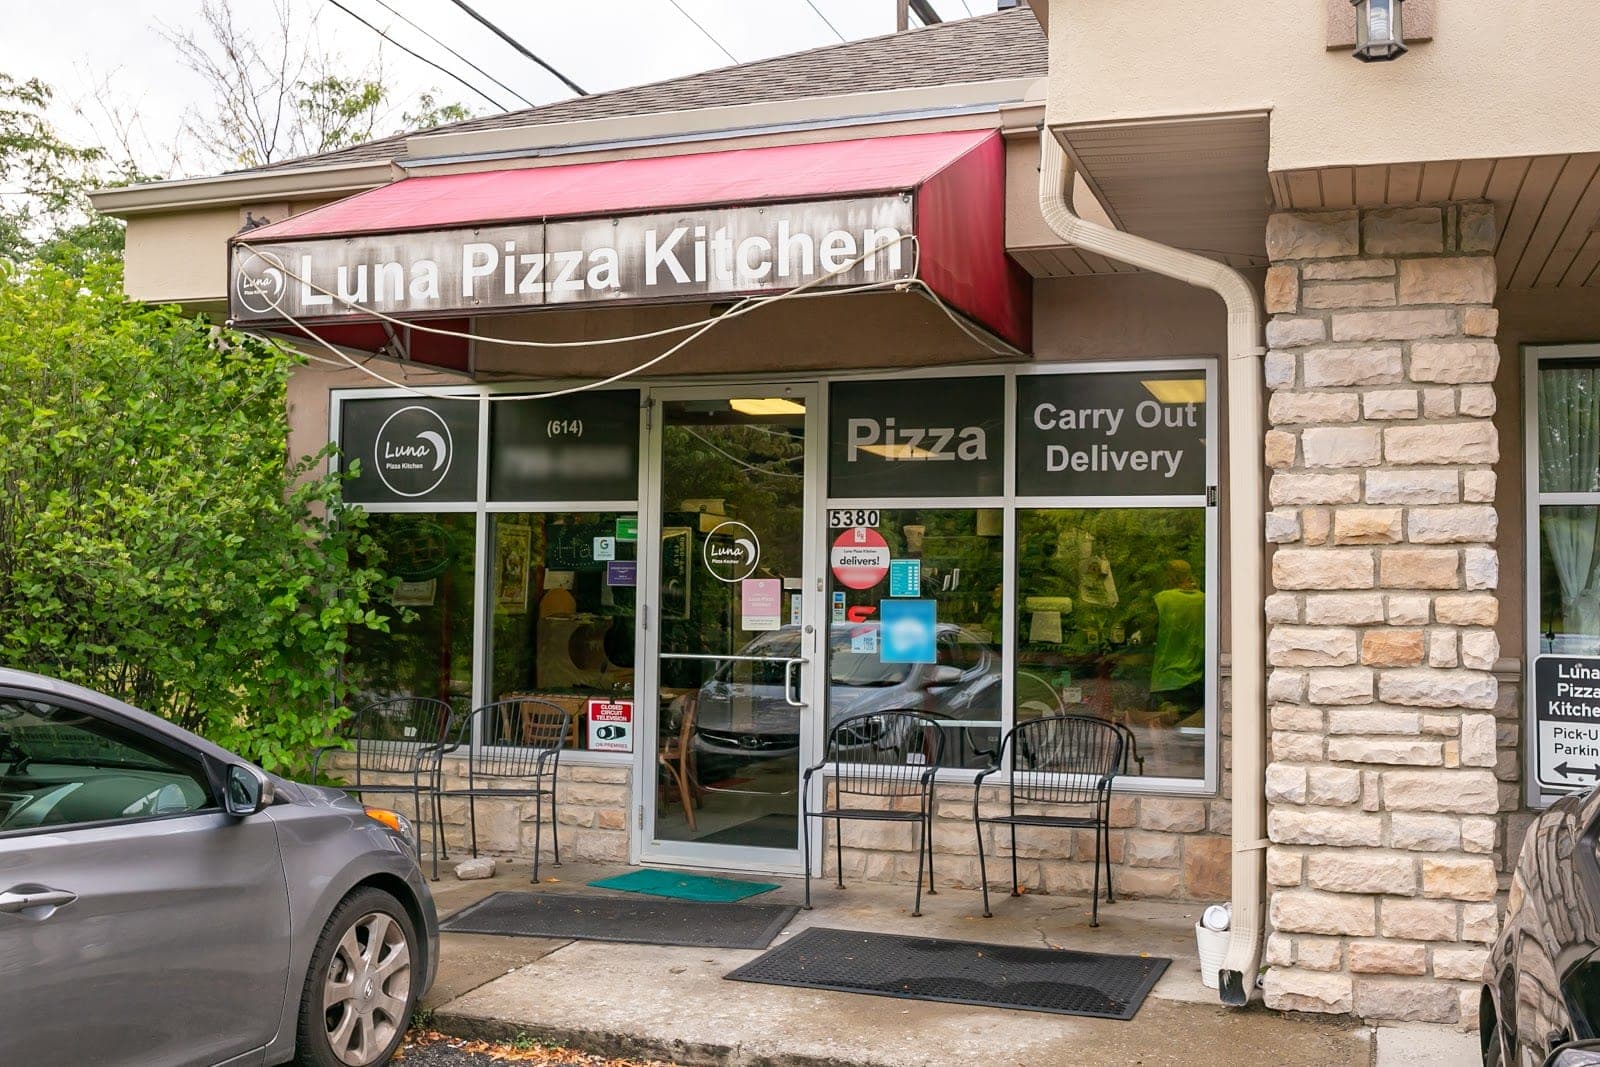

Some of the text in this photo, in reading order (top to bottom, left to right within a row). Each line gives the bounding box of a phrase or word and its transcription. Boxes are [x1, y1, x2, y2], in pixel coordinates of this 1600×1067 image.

[301, 219, 903, 306] Luna Pizza Kitchen
[1033, 399, 1197, 436] Carry Out
[547, 419, 583, 438] (614)
[847, 417, 988, 462] Pizza
[385, 441, 430, 459] Luna
[1046, 444, 1184, 478] Delivery
[831, 510, 879, 527] 5380
[711, 543, 744, 557] Luna
[839, 556, 880, 566] delivers!
[1558, 663, 1600, 680] Luna
[1557, 682, 1600, 699] Pizza
[1548, 700, 1600, 718] Kitche
[1553, 727, 1600, 741] Pick-U
[1554, 742, 1600, 757] Parkin
